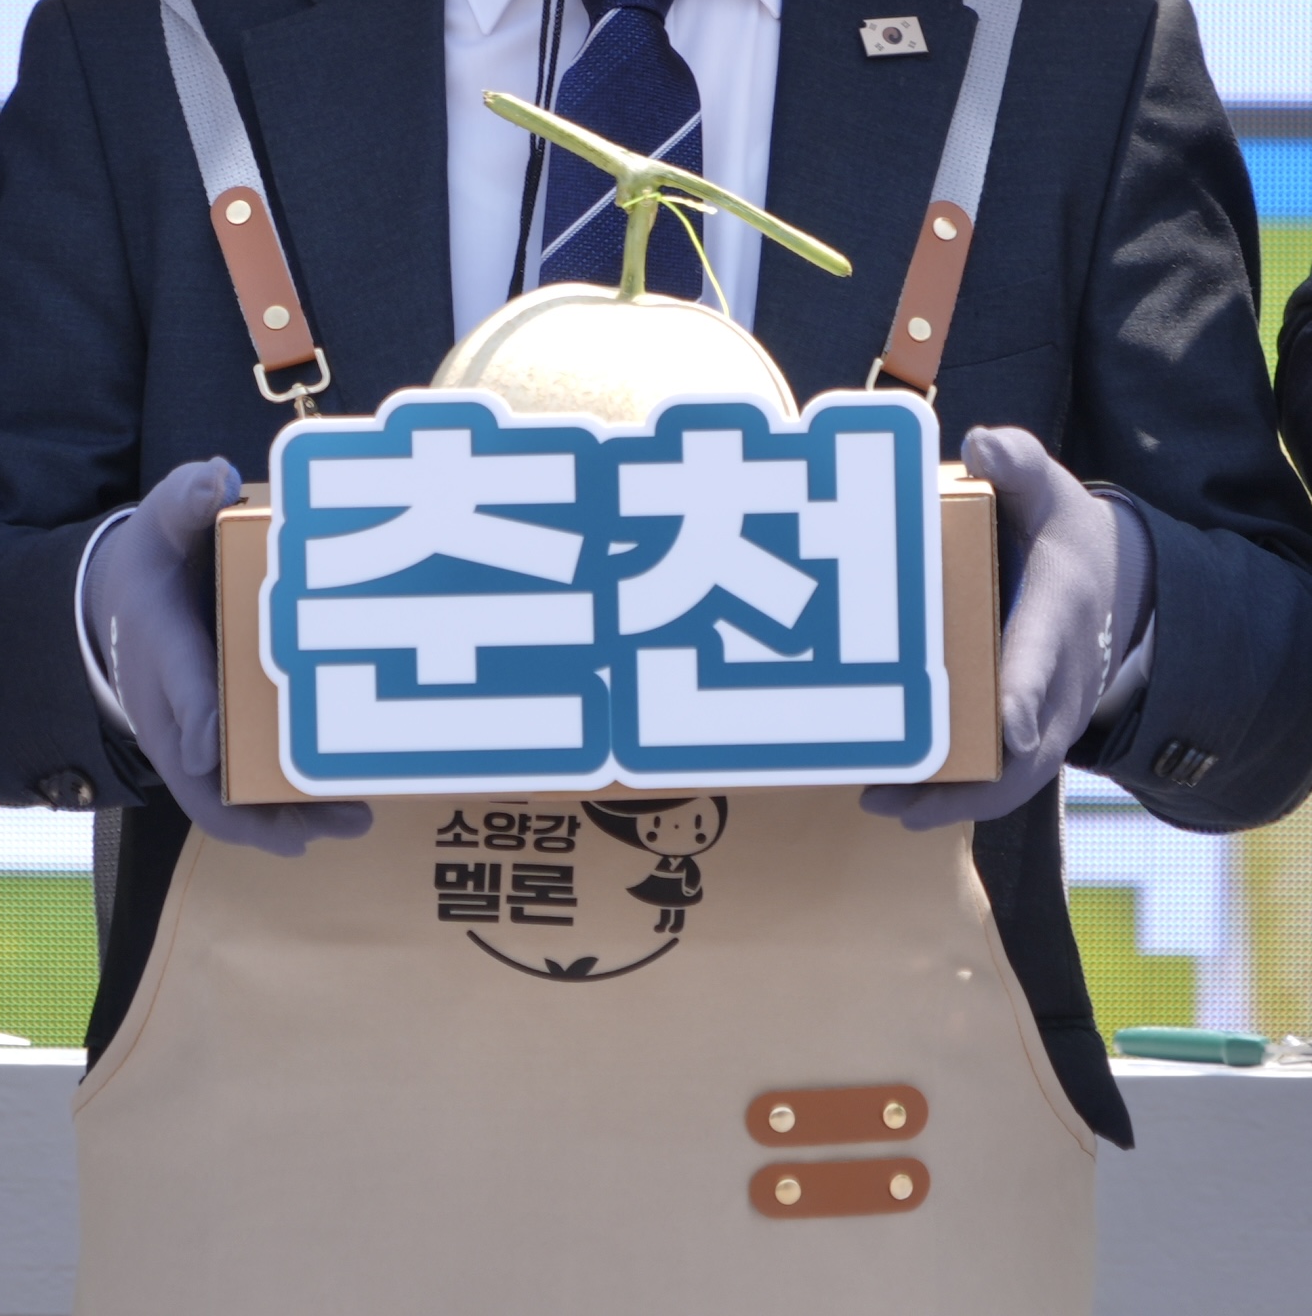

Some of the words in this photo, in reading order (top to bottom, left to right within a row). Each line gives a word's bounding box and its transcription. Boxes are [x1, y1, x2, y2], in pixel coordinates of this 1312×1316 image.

[297, 428, 905, 755] 춘천
[435, 809, 581, 854] 소양강
[434, 862, 578, 927] 멜론
